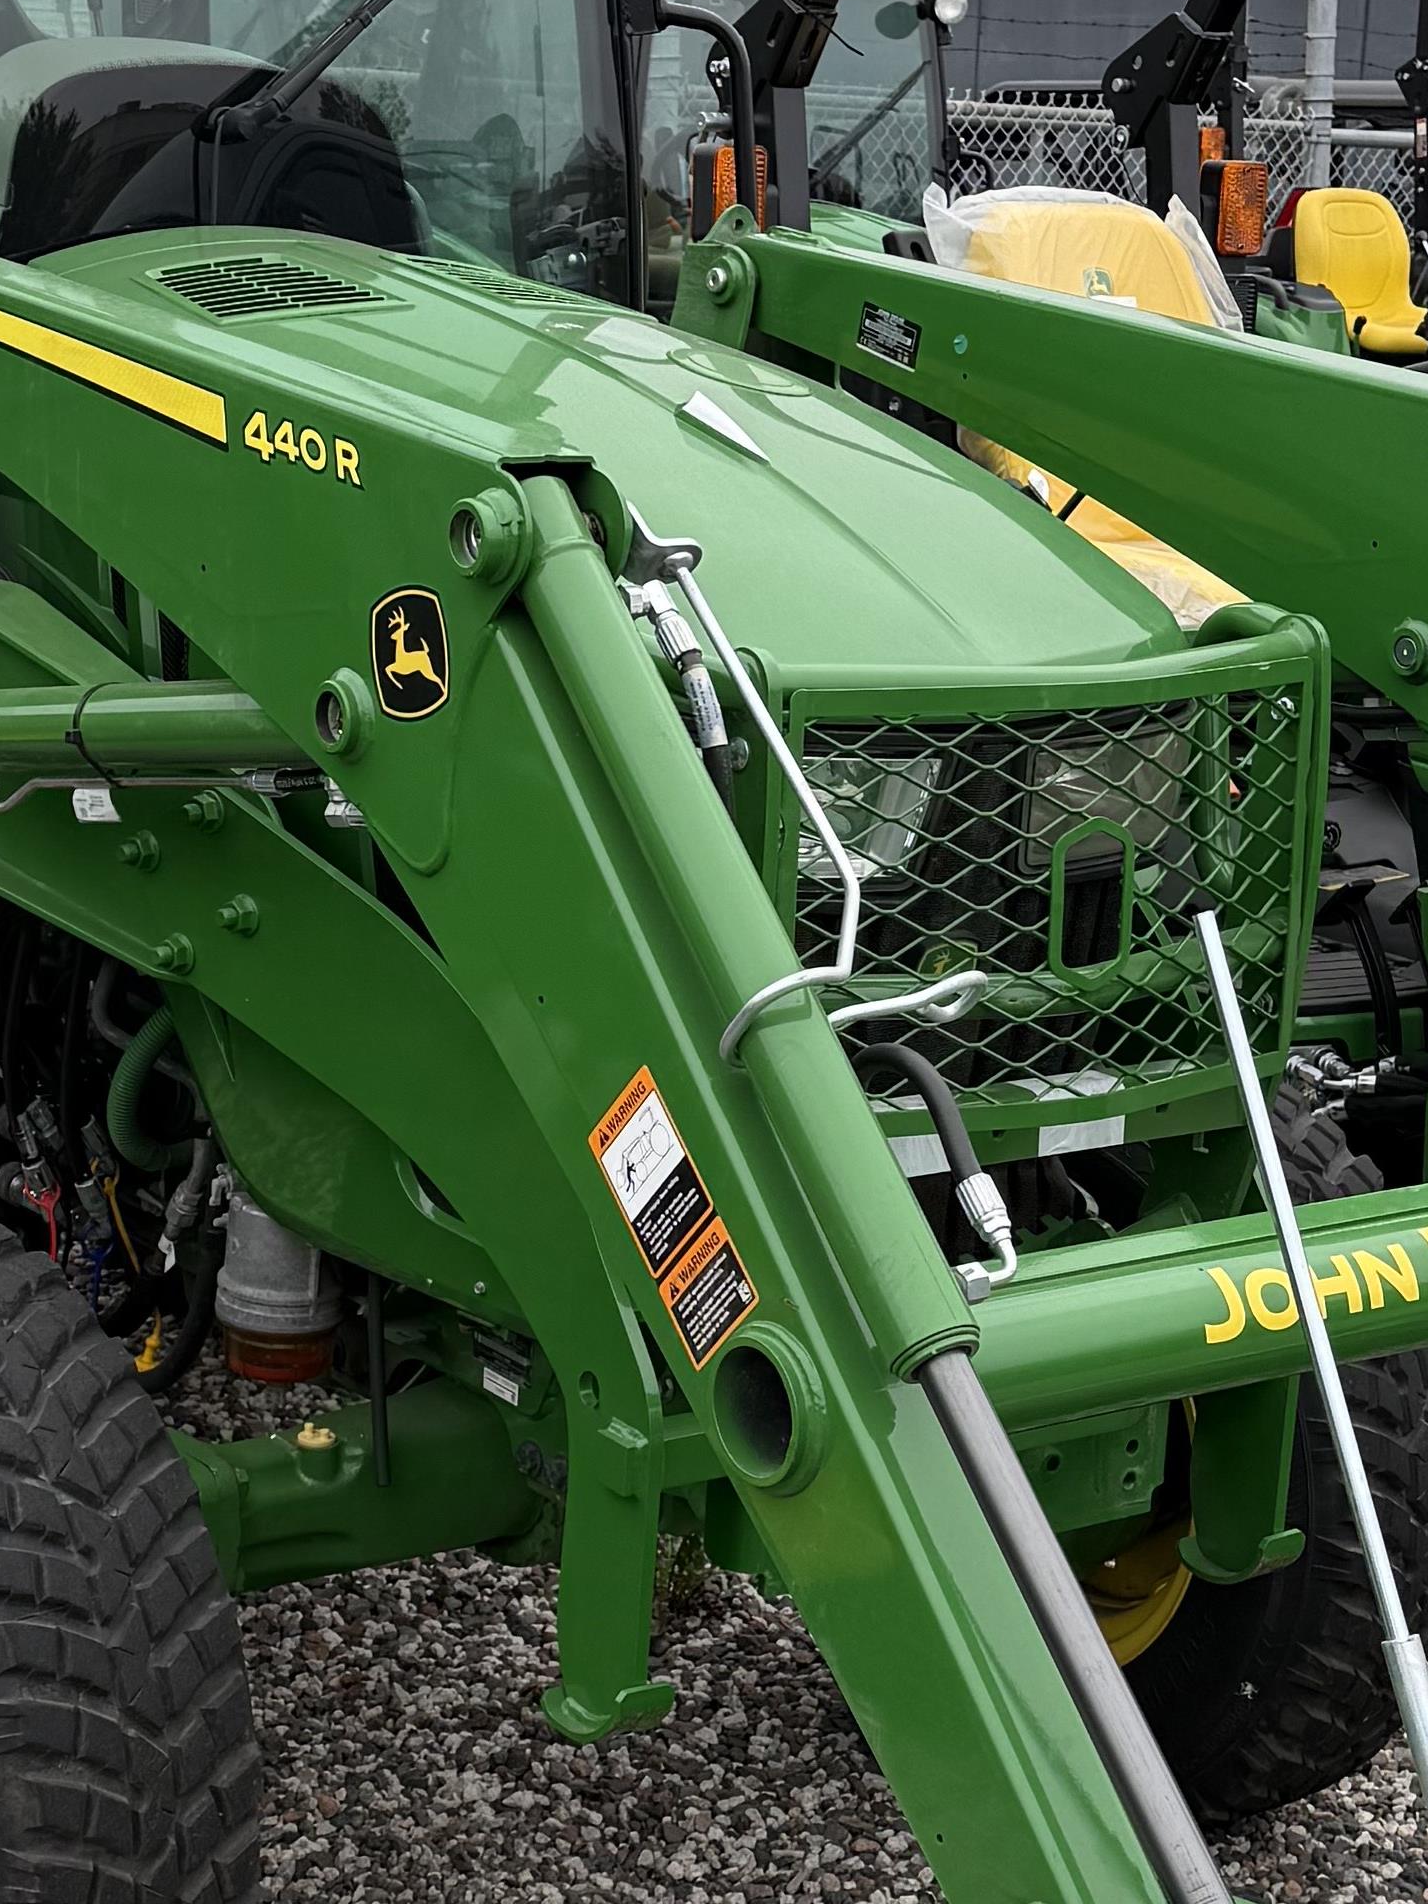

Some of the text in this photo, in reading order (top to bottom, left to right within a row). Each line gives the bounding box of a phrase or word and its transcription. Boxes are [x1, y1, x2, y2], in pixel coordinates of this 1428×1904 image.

[243, 410, 364, 488] 440 R
[606, 1079, 648, 1136] WARNING
[677, 1230, 722, 1285] WARNING
[1203, 1242, 1421, 1346] JOHN
